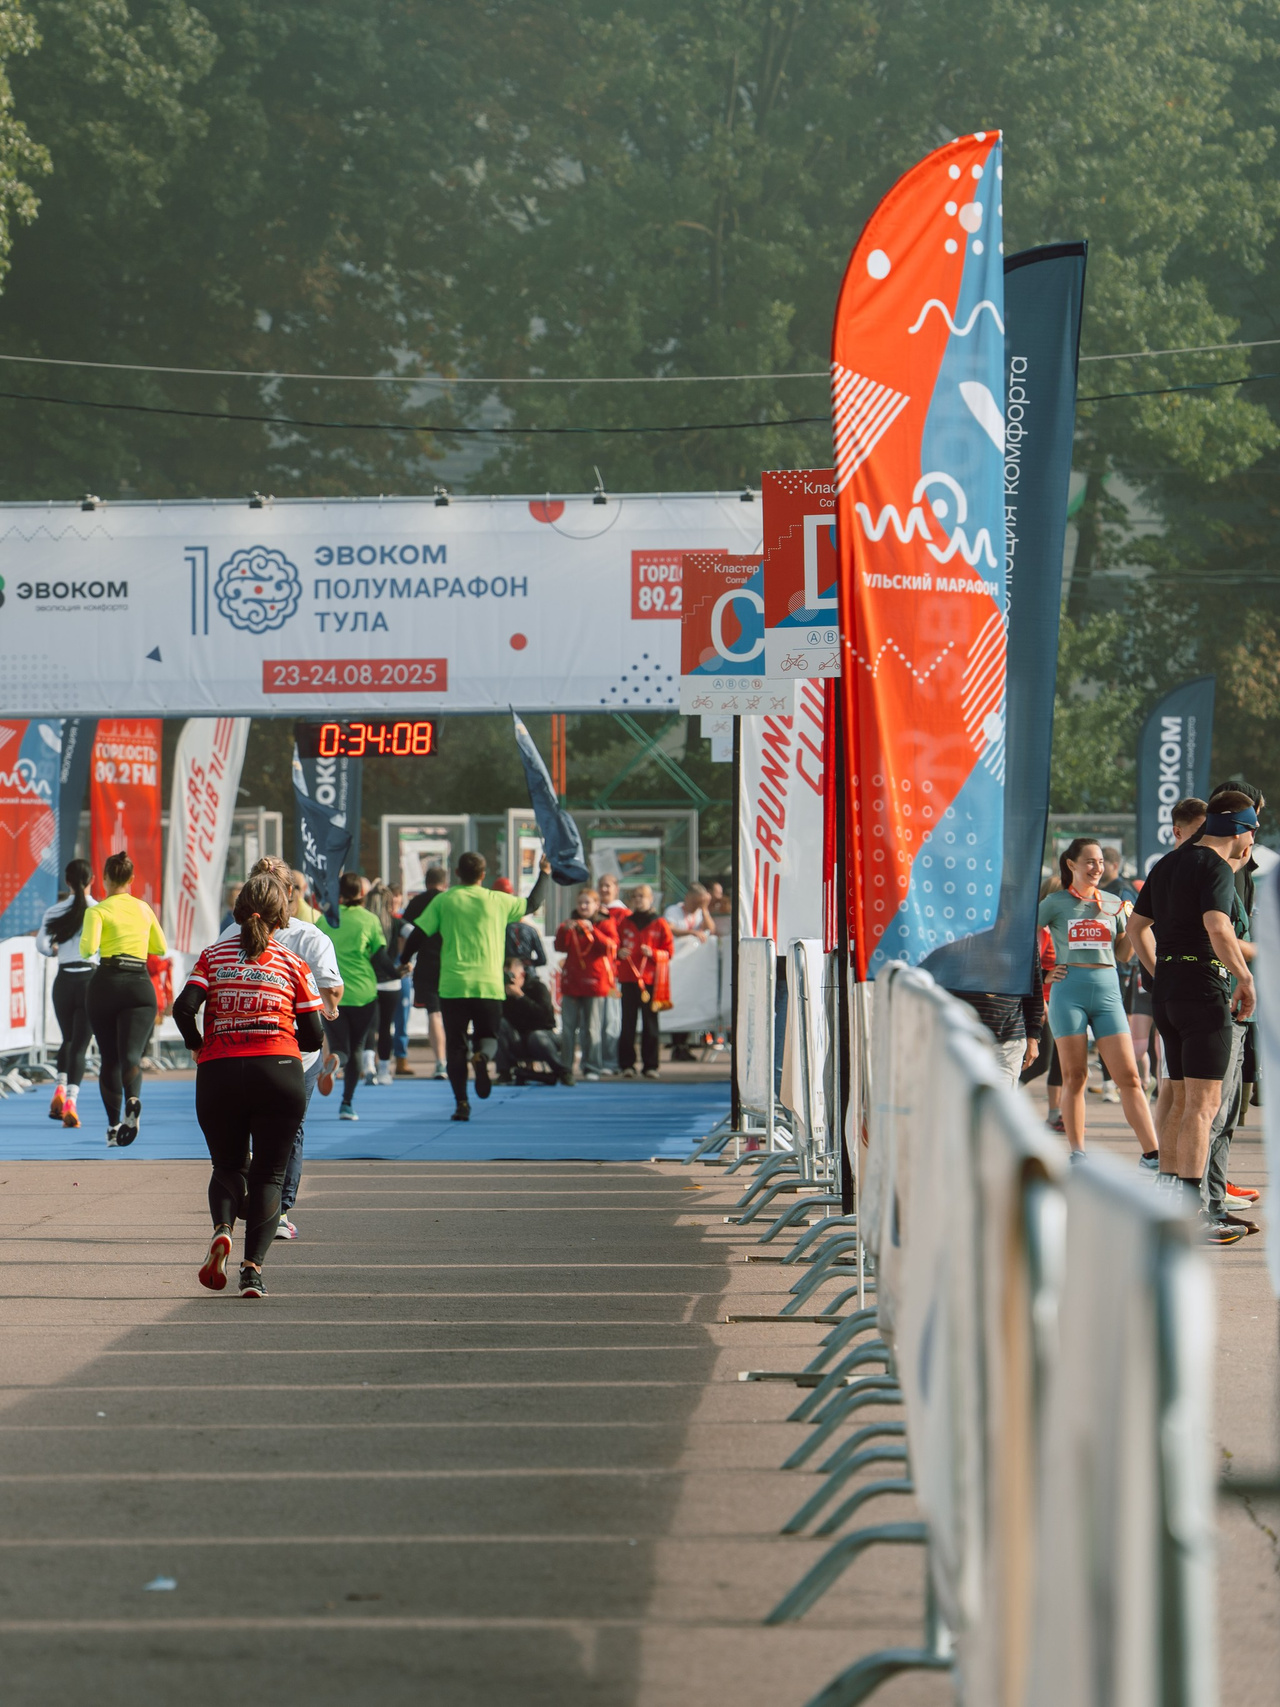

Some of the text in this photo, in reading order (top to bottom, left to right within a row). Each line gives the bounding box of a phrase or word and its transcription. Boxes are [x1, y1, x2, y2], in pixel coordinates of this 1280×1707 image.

[803, 481, 836, 494] Клас
[314, 545, 448, 566] ЭВОКОМ
[714, 563, 760, 575] Кластер
[16, 581, 129, 600] ЭВОКОМ
[313, 576, 529, 600] ПОЛУМАРАФОН
[936, 576, 999, 597] МАРАФОН
[314, 612, 390, 634] ТУЛА
[710, 588, 765, 663] C
[273, 664, 437, 686] 23-24.08.2025
[318, 722, 433, 757] 0:34:08
[95, 742, 158, 762] ГОРДОСТЬ
[95, 761, 157, 786] 89.2 FM
[1157, 716, 1182, 845] ЭВОКОМ
[756, 714, 793, 863] RUNN
[198, 781, 218, 863] CLUB
[1079, 928, 1102, 937] 2105
[216, 967, 287, 989] Saint-Petersburg
